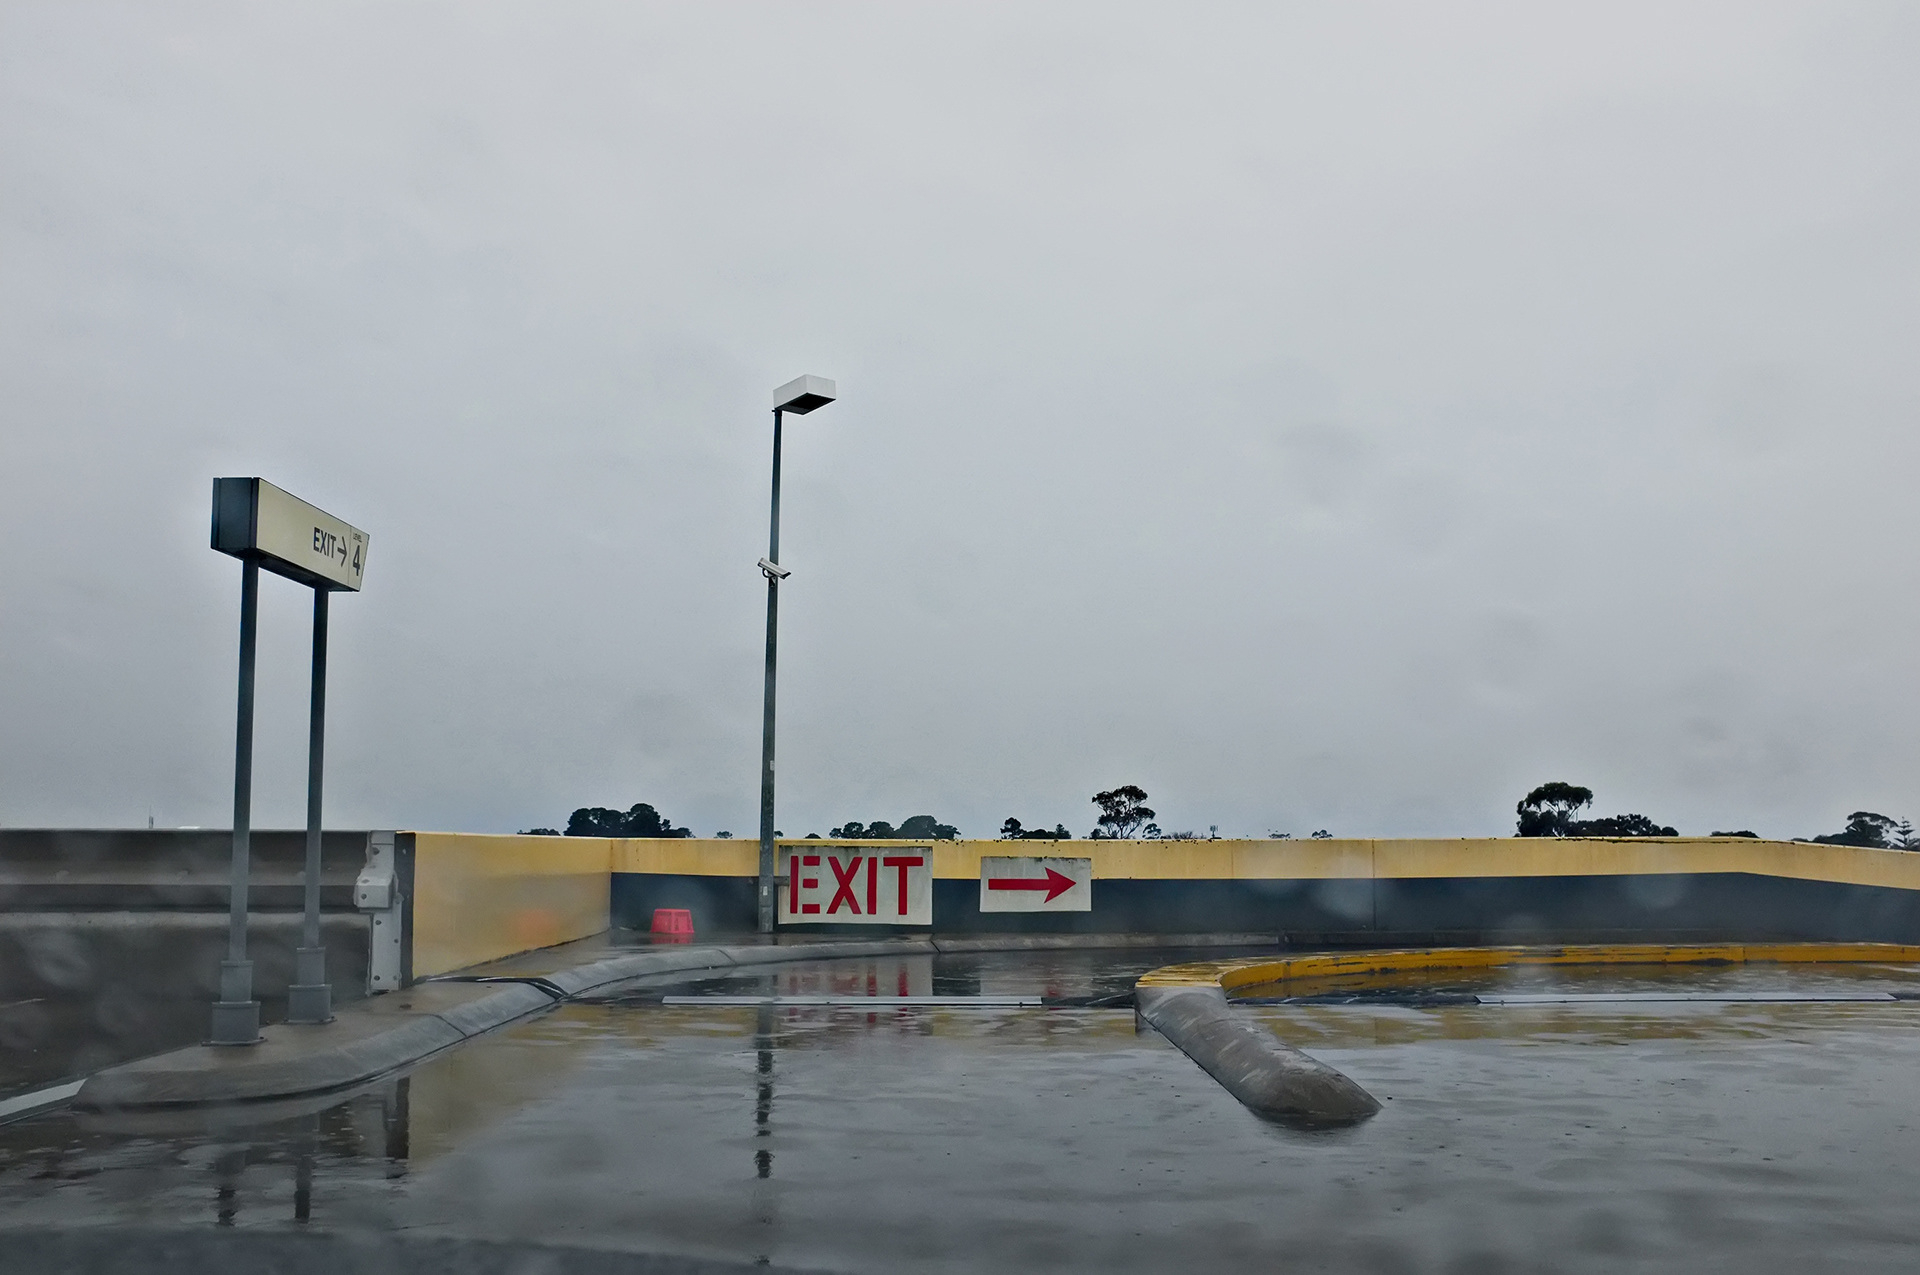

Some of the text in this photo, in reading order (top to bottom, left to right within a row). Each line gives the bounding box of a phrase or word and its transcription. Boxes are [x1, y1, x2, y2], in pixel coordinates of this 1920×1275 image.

[313, 526, 337, 559] EXIT
[352, 545, 361, 577] 4
[789, 855, 924, 915] EXIT
